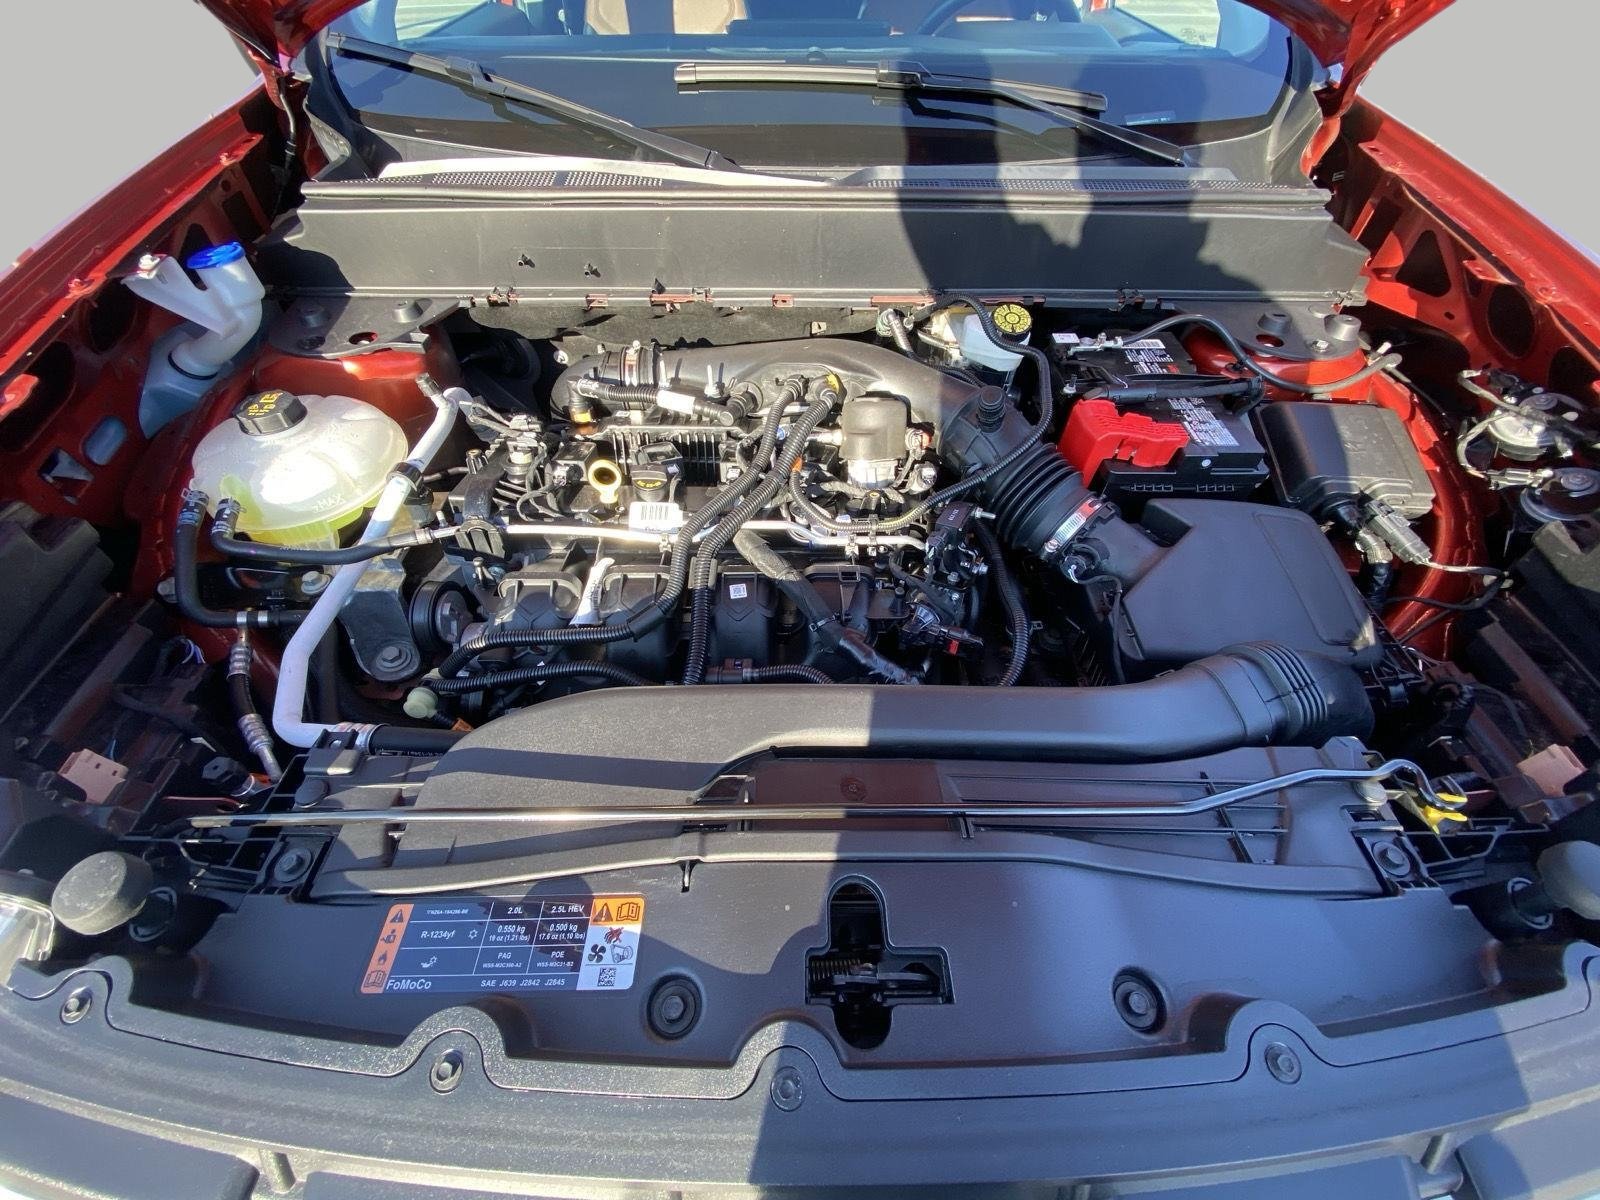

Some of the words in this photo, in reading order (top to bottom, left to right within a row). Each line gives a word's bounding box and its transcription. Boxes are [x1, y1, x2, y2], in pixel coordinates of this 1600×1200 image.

[507, 906, 523, 914] 2.0L
[551, 905, 567, 913] 2.5L
[568, 904, 585, 913] HEV
[497, 925, 516, 933] 0.550
[516, 924, 526, 934] kg
[549, 923, 568, 931] 0.500
[568, 923, 578, 933] kg
[420, 929, 456, 940] R-1234yf
[504, 934, 518, 942] (1.21
[518, 933, 531, 942] lbs)
[574, 932, 586, 940] lbs)
[386, 978, 432, 990] FoMoCo
[480, 979, 497, 988] SAE
[499, 979, 517, 988] J639
[519, 978, 541, 987] J2842
[544, 978, 566, 987] J2845
